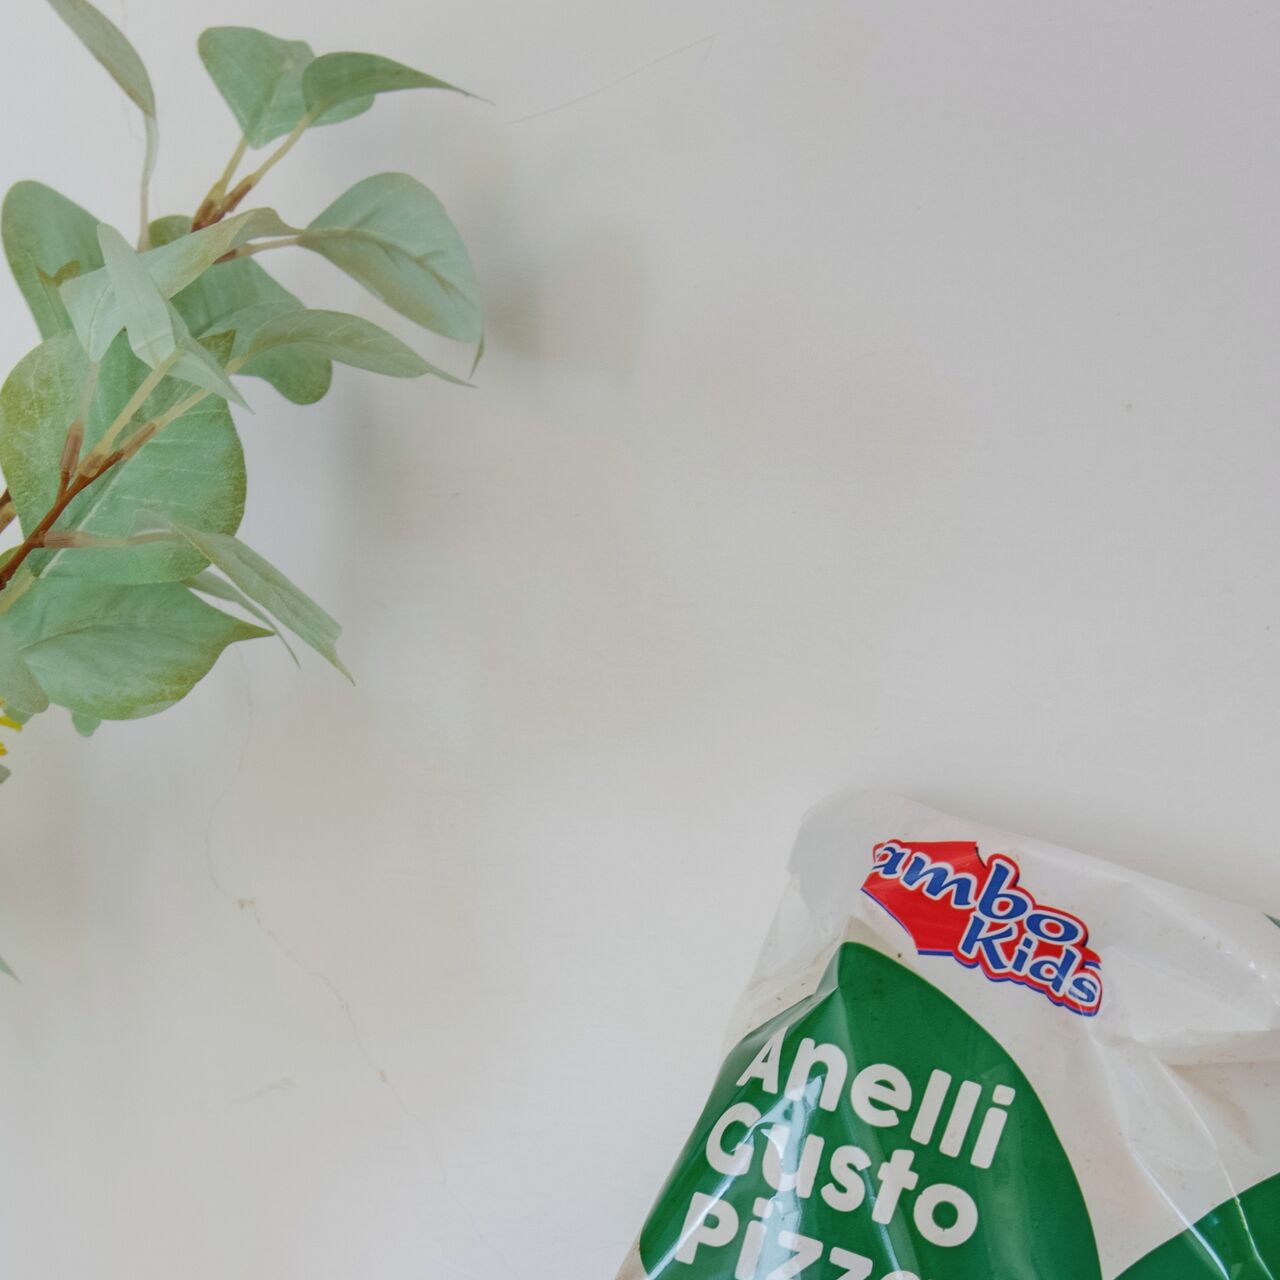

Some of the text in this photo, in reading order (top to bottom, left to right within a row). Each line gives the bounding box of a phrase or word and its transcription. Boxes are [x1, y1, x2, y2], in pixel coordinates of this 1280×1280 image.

[961, 913, 1098, 1003] Kids
[735, 1025, 1016, 1170] Anelli
[705, 1101, 979, 1248] Gusto
